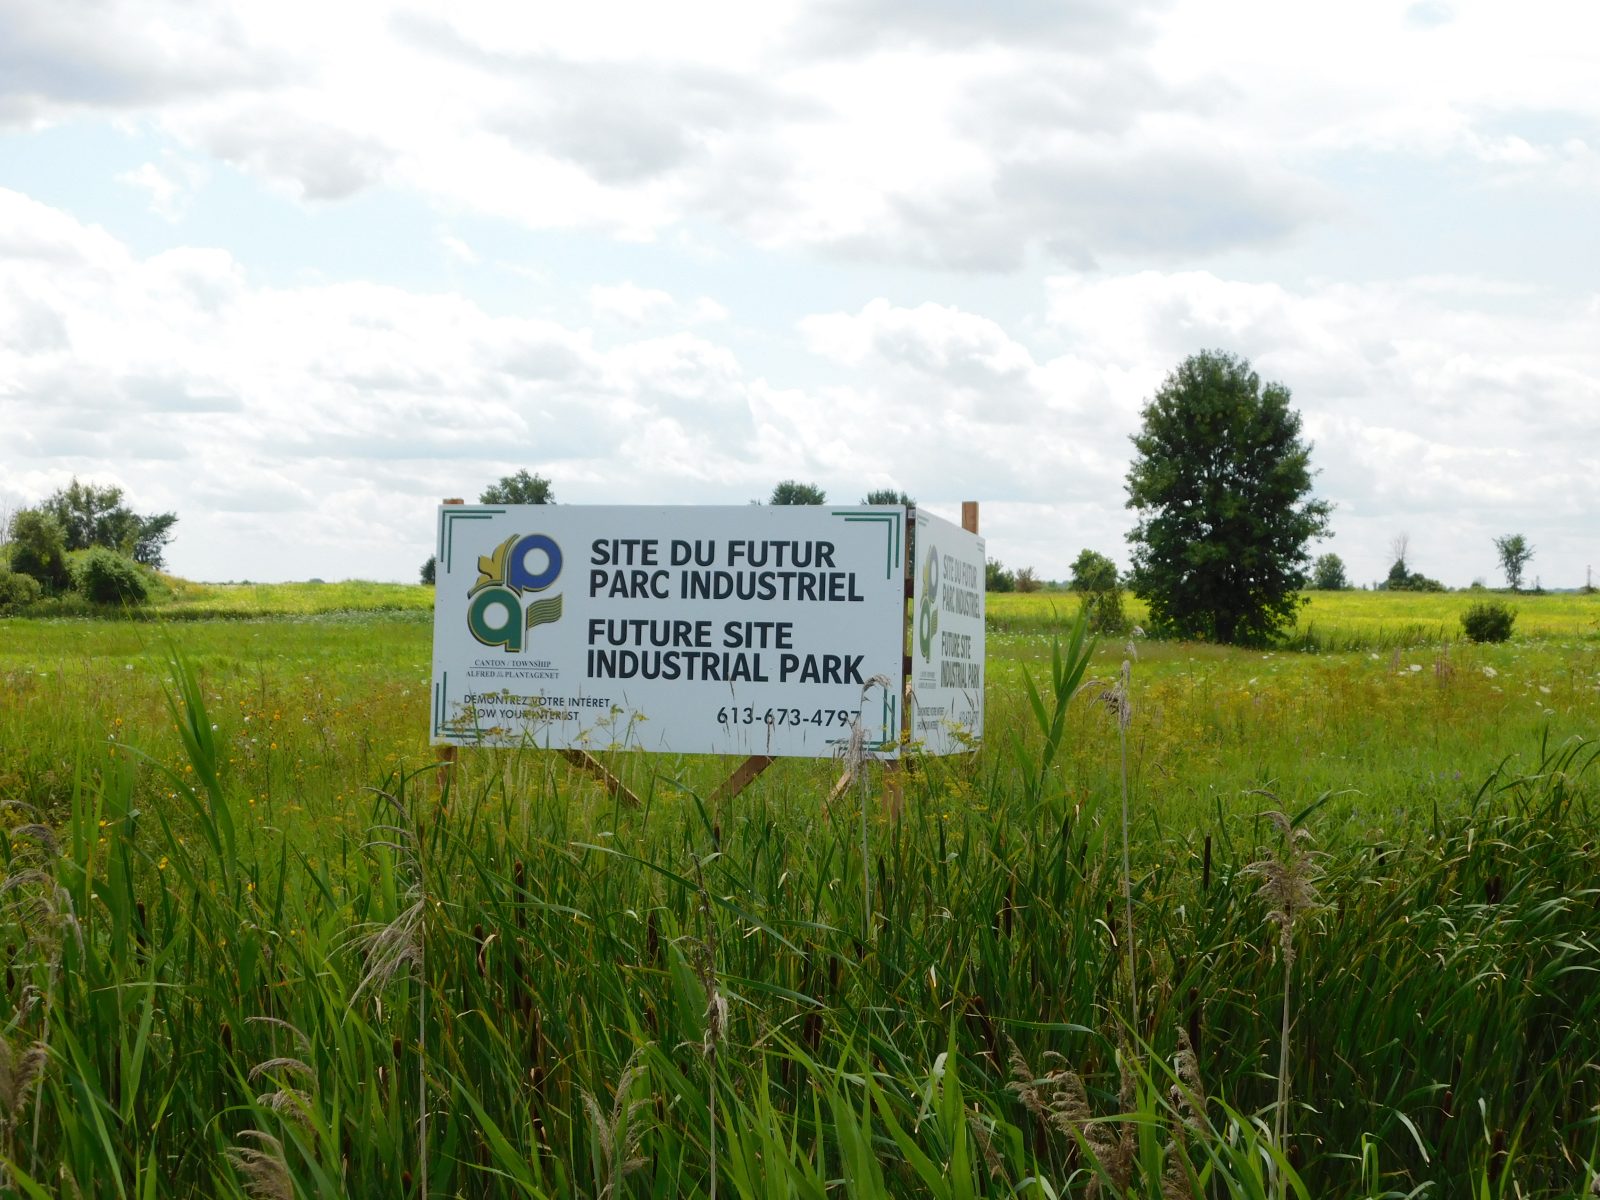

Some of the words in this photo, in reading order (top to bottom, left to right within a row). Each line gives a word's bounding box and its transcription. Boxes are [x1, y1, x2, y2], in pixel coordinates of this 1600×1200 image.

[590, 538, 659, 567] SITE
[670, 539, 716, 567] DU
[727, 540, 837, 568] FUTUR
[588, 568, 671, 599] PARC
[680, 570, 865, 602] INDUSTRIEL
[943, 553, 954, 582] SITE
[954, 558, 962, 585] DU
[962, 561, 978, 589] FUTUR
[942, 582, 955, 613] PARC
[588, 618, 713, 648] FUTURE
[722, 620, 794, 649] SITE
[941, 630, 960, 657] FUTURE
[960, 634, 971, 660] SITE
[466, 670, 496, 678] ALFRED
[504, 671, 560, 679] PLANTAGENET
[474, 659, 506, 667] CANTON
[512, 660, 551, 668] TOWNSHIP
[587, 649, 770, 683] INDUSTRIAL
[779, 653, 865, 686] PARK
[967, 663, 981, 689] PARK
[717, 706, 862, 728] 613-673-4797
